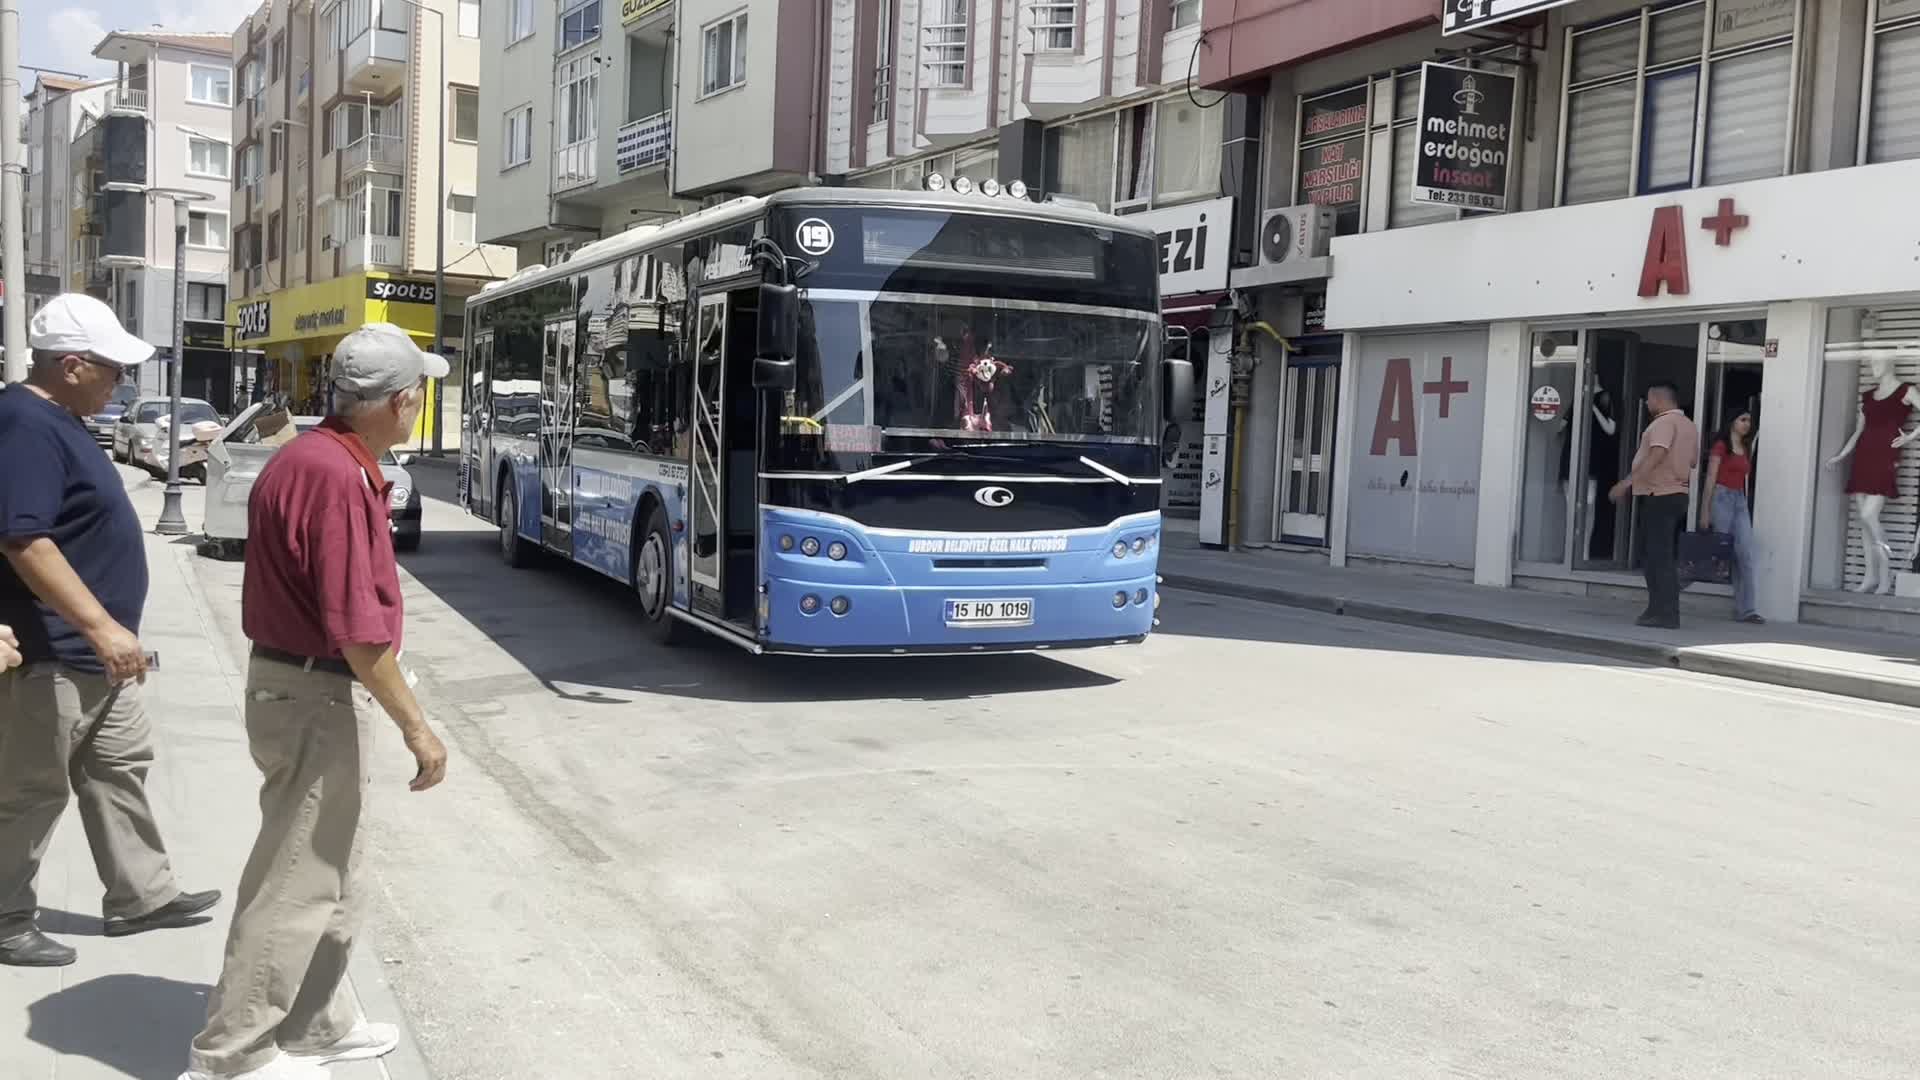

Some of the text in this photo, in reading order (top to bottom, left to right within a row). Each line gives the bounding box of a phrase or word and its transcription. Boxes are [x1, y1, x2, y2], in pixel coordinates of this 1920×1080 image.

[1427, 115, 1506, 141] mehmet
[1424, 140, 1505, 167] erdoğan
[1428, 189, 1446, 201] Tel:
[802, 225, 829, 247] 19
[1637, 198, 1749, 296] A+
[1369, 357, 1469, 457] A+
[955, 602, 1028, 617] 15 HO 1019
